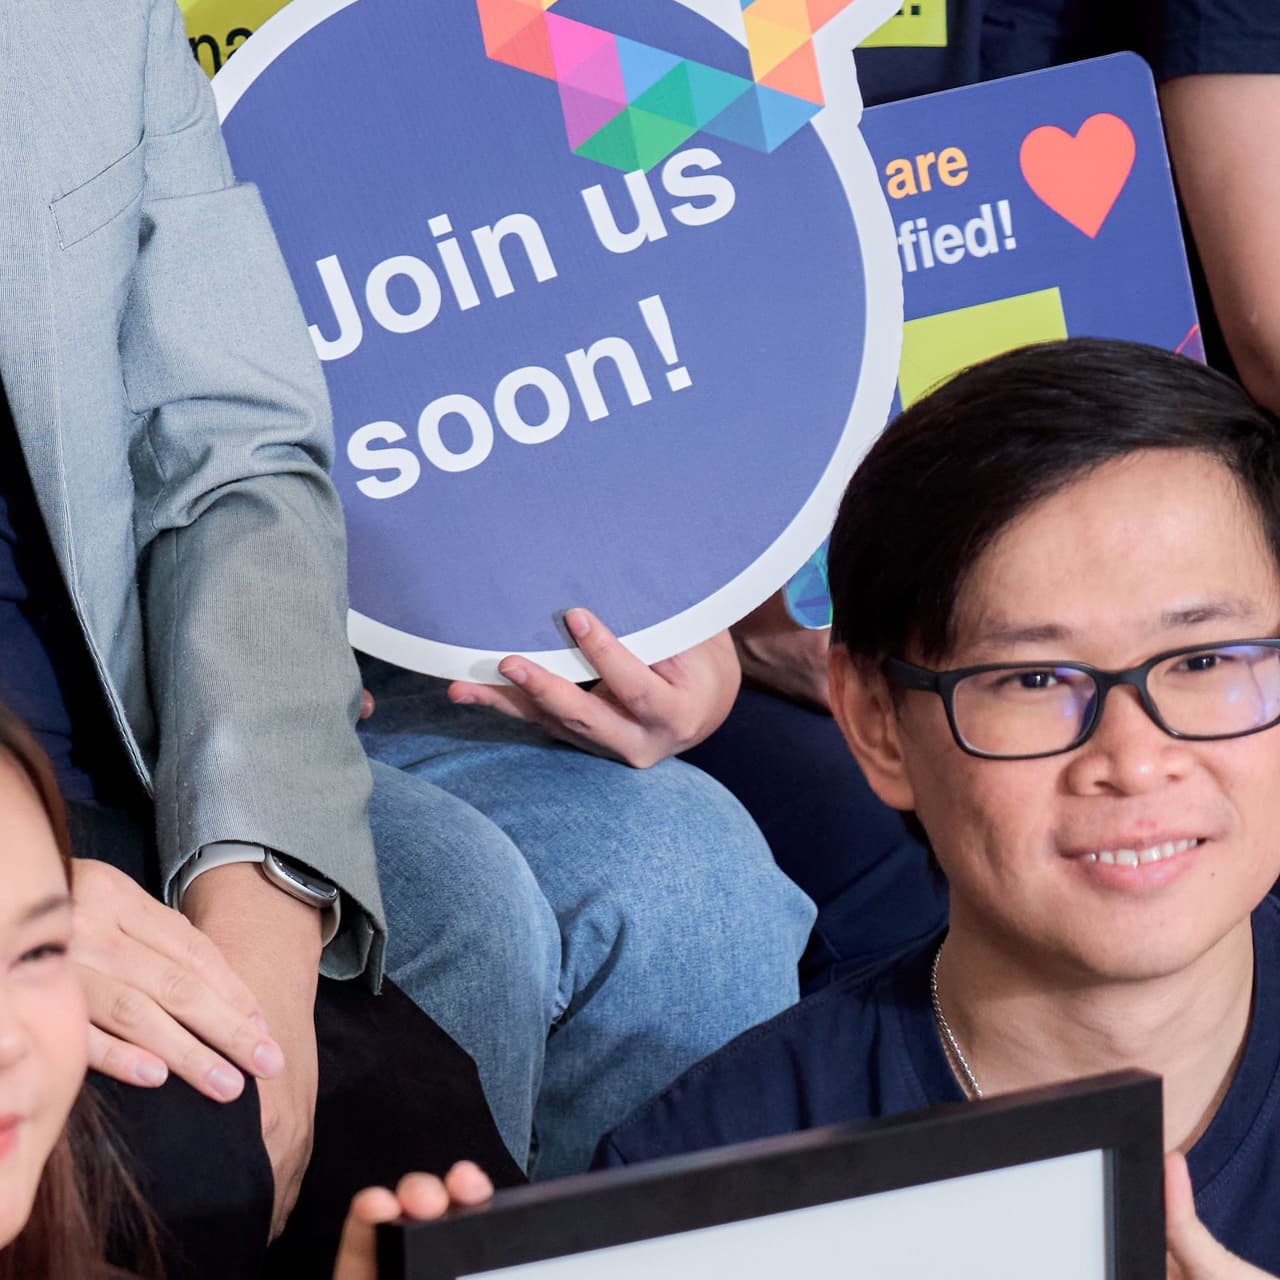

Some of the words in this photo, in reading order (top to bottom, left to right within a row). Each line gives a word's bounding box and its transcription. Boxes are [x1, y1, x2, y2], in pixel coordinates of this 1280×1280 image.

[307, 213, 559, 362] Join
[580, 147, 737, 254] us
[885, 146, 969, 200] are
[346, 293, 694, 500] soon!
